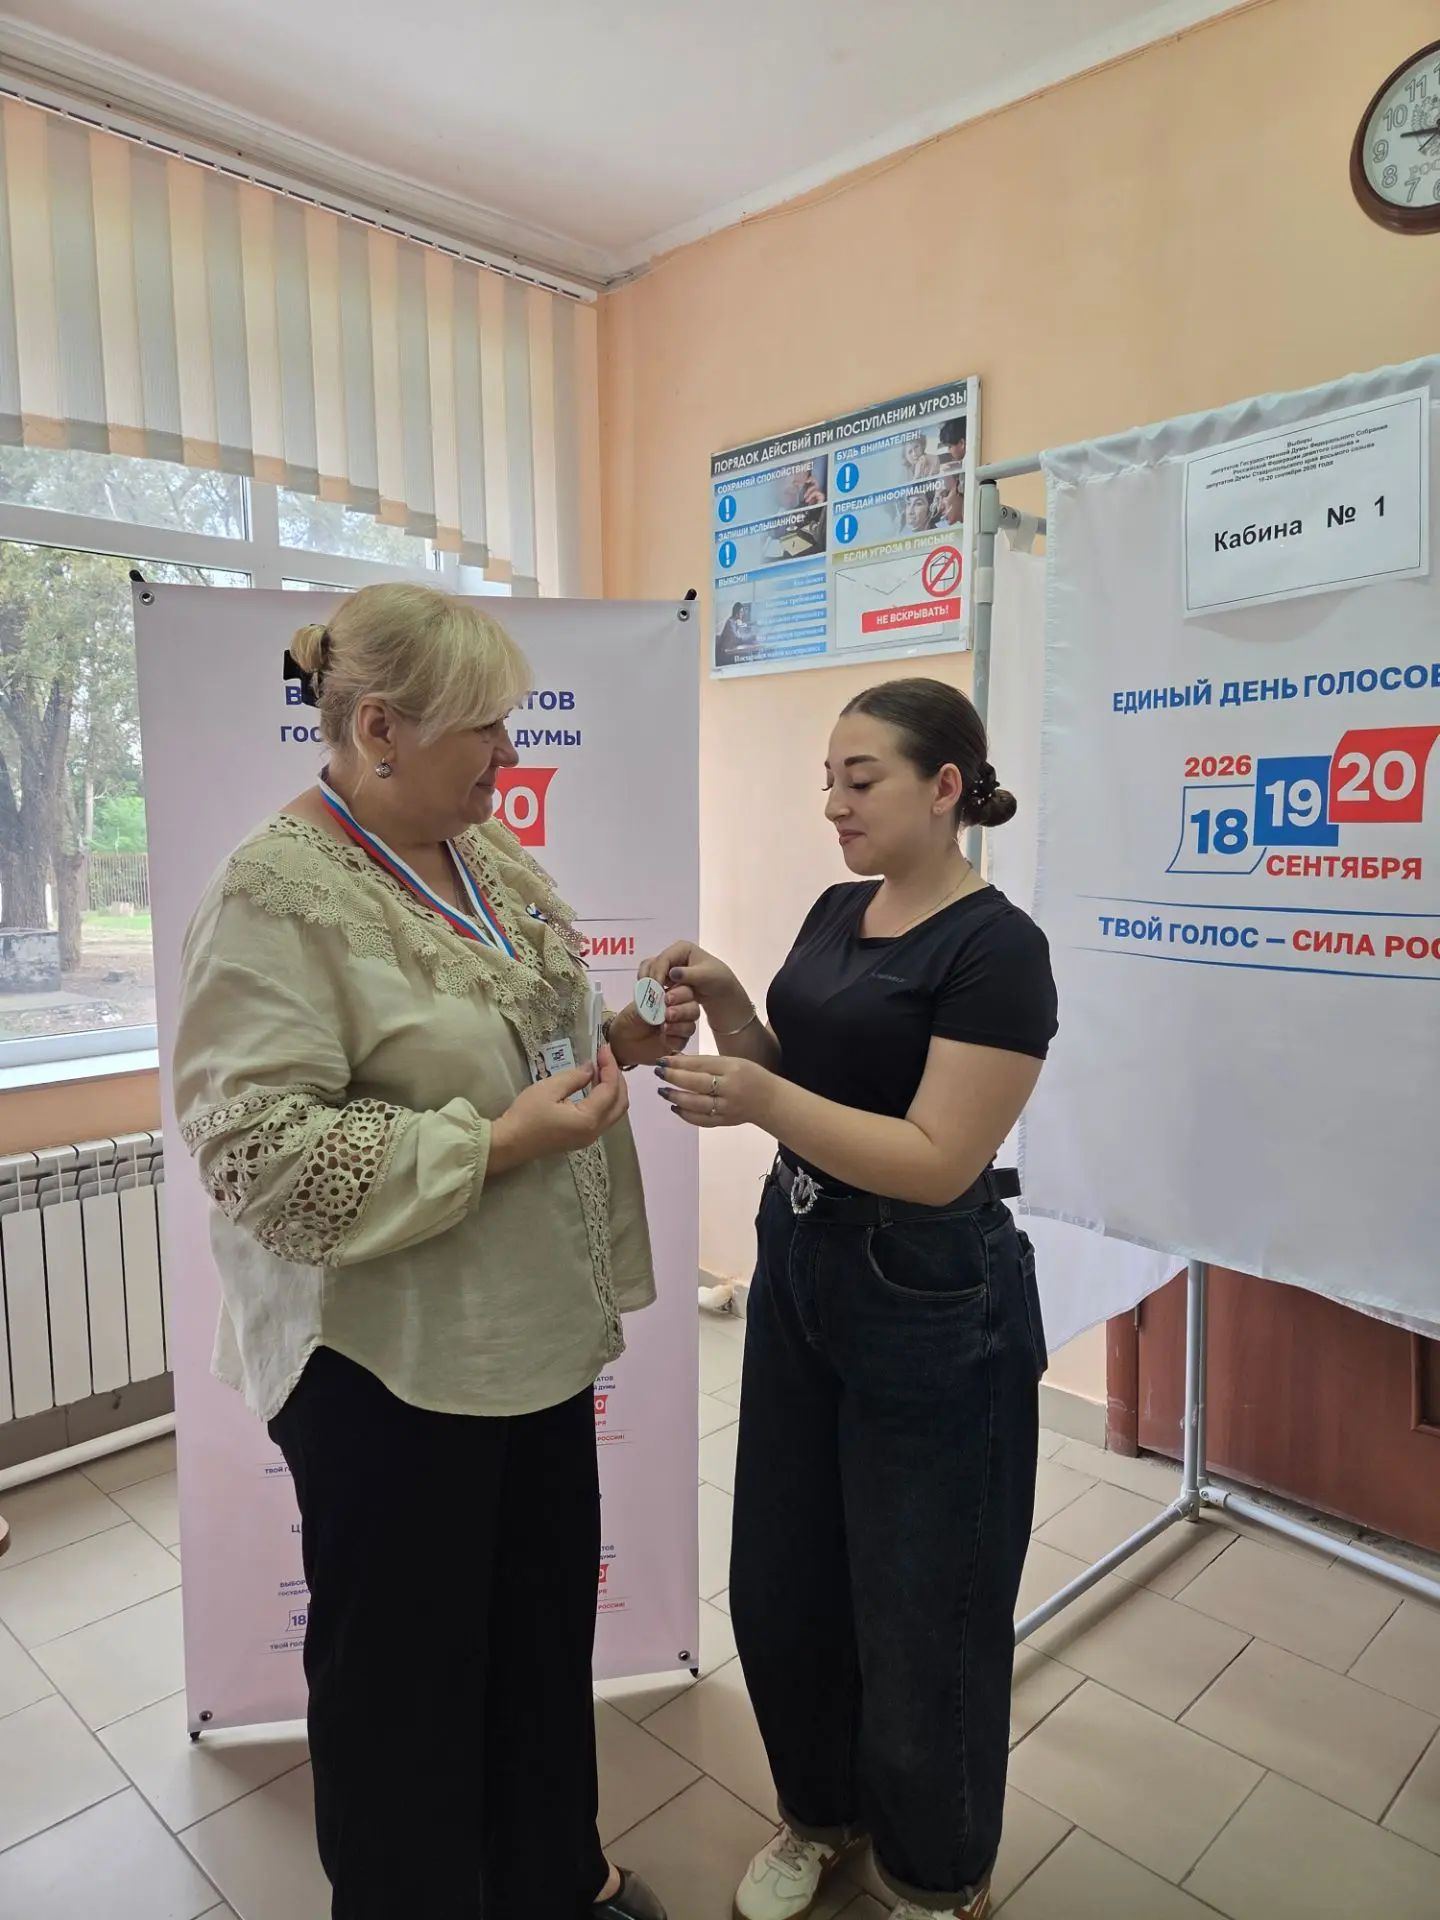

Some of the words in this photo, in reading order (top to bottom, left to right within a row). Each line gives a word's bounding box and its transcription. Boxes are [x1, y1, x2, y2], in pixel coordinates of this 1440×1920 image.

[1404, 74, 1427, 103] 11
[1383, 104, 1408, 131] 10
[1373, 139, 1390, 163] 9
[1381, 164, 1398, 189] 8
[1404, 177, 1421, 203] 7
[714, 450, 760, 474] ПОРЯДОК
[761, 433, 811, 461] ДЕЙСТВИЙ
[814, 428, 834, 446] ПРИ
[836, 404, 916, 439] ПОСТУПЛЕНИИ
[919, 389, 967, 415] УГРОЗЫ
[836, 448, 859, 461] БУДЬ
[860, 430, 921, 455] ВНИМАТЕЛЕН!
[1291, 445, 1309, 455] Думы
[717, 477, 755, 495] СОХРАНЯЙ
[756, 461, 814, 485] СПОКОЙСТВИЕ!
[834, 496, 874, 513] ПЕРЕДАЙ
[874, 480, 945, 505] ИНФОРМАЦИЮ!
[1214, 518, 1303, 552] Кабина
[1327, 505, 1357, 528] №
[1374, 495, 1386, 517] 1
[843, 548, 868, 562] ЕСЛИ
[869, 541, 903, 560] УГРОЗА
[904, 540, 912, 551] В
[876, 614, 889, 625] НЕ
[890, 604, 950, 623] ВСКРЫВАТЬ!
[1113, 679, 1212, 714] ЕДИНЫЙ
[1219, 677, 1299, 707] ДЕНЬ
[514, 729, 582, 748] ДУМЫ
[1184, 754, 1253, 778] 2026
[1337, 750, 1417, 802] 20
[1265, 778, 1322, 828] 19
[1190, 808, 1249, 855] 18
[1266, 854, 1423, 881] СЕНТЯБРЯ
[1098, 916, 1163, 942] ТВОЙ
[1169, 923, 1260, 949] ГОЛОС
[1292, 929, 1376, 956] СИЛА
[292, 1615, 307, 1626] 18
